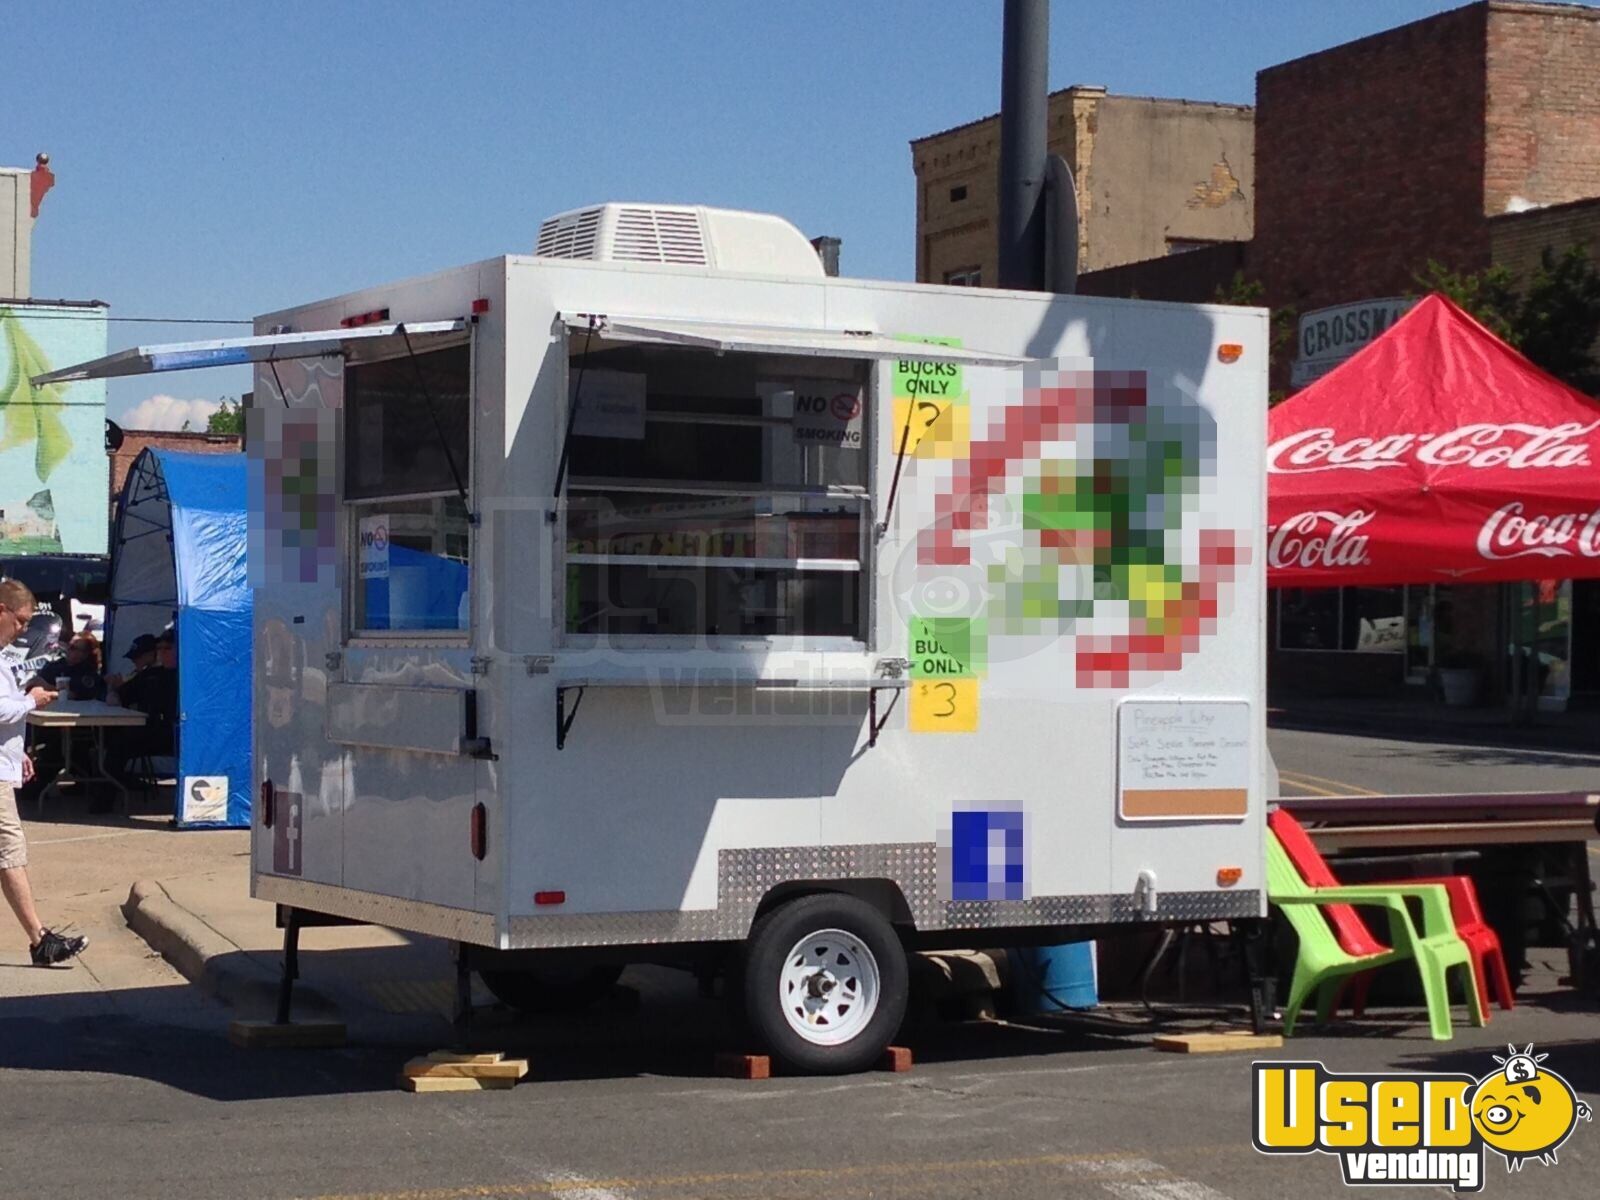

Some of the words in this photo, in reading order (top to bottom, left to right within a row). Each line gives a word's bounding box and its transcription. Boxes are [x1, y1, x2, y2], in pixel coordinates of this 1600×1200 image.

[898, 360, 957, 376] BUCKS
[905, 379, 949, 394] ONLY
[796, 395, 827, 412] NO
[796, 427, 861, 442] SMOKING
[1266, 420, 1600, 474] Coca-Cola
